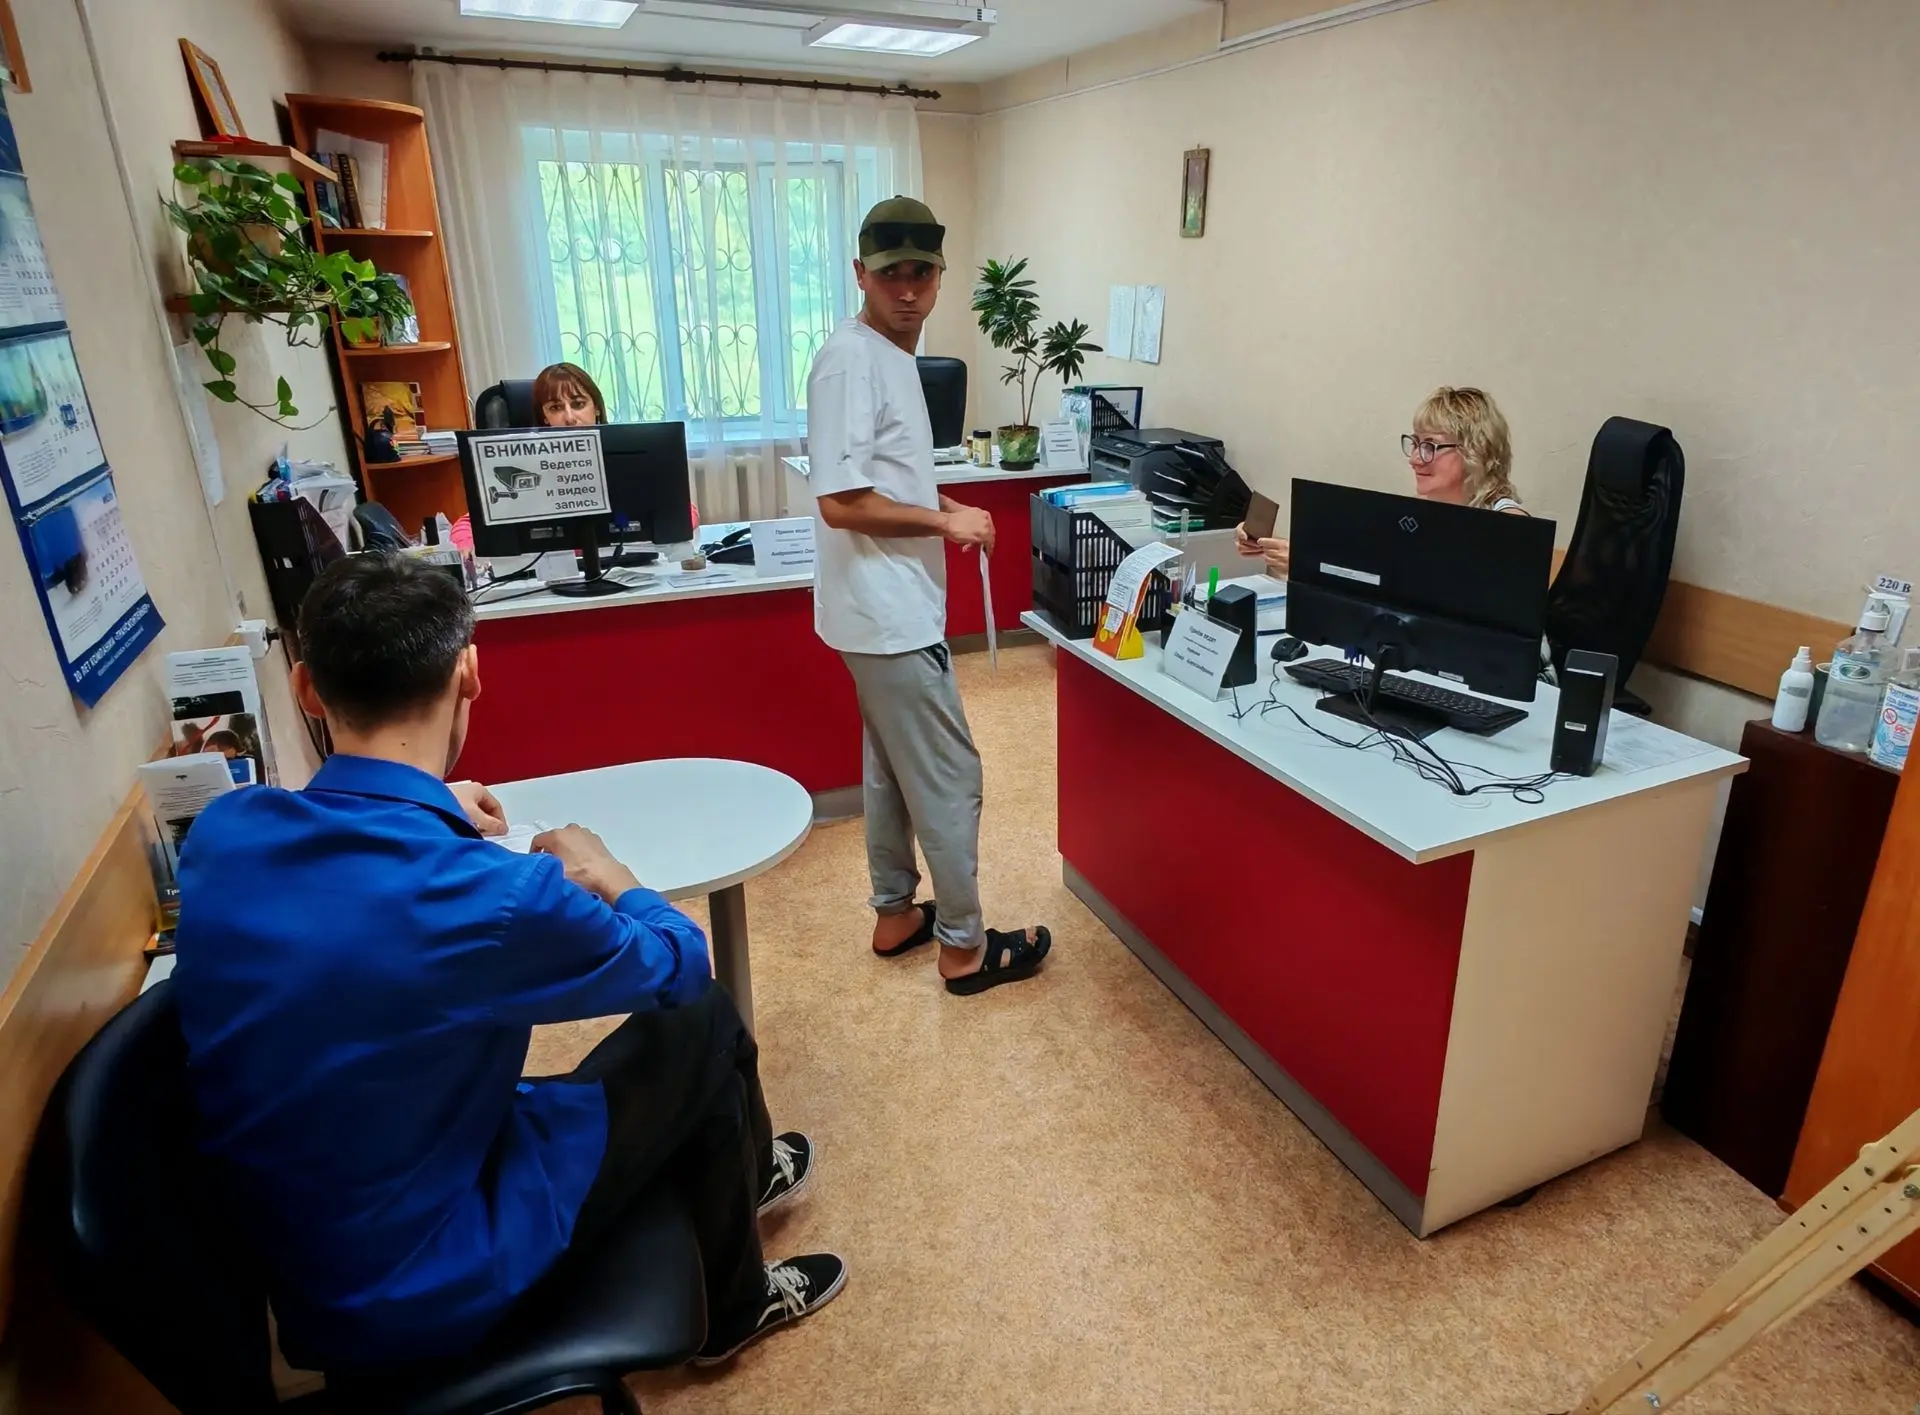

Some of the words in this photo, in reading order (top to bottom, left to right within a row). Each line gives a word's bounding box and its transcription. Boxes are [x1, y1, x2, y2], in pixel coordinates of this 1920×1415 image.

[484, 439, 592, 458] ВНИМАНИЕ!
[540, 459, 593, 471] Ведется
[557, 472, 595, 485] аудио
[546, 489, 555, 497] и
[558, 486, 597, 496] видео
[555, 500, 599, 511] запись
[1879, 577, 1900, 591] 220
[1902, 583, 1912, 593] В
